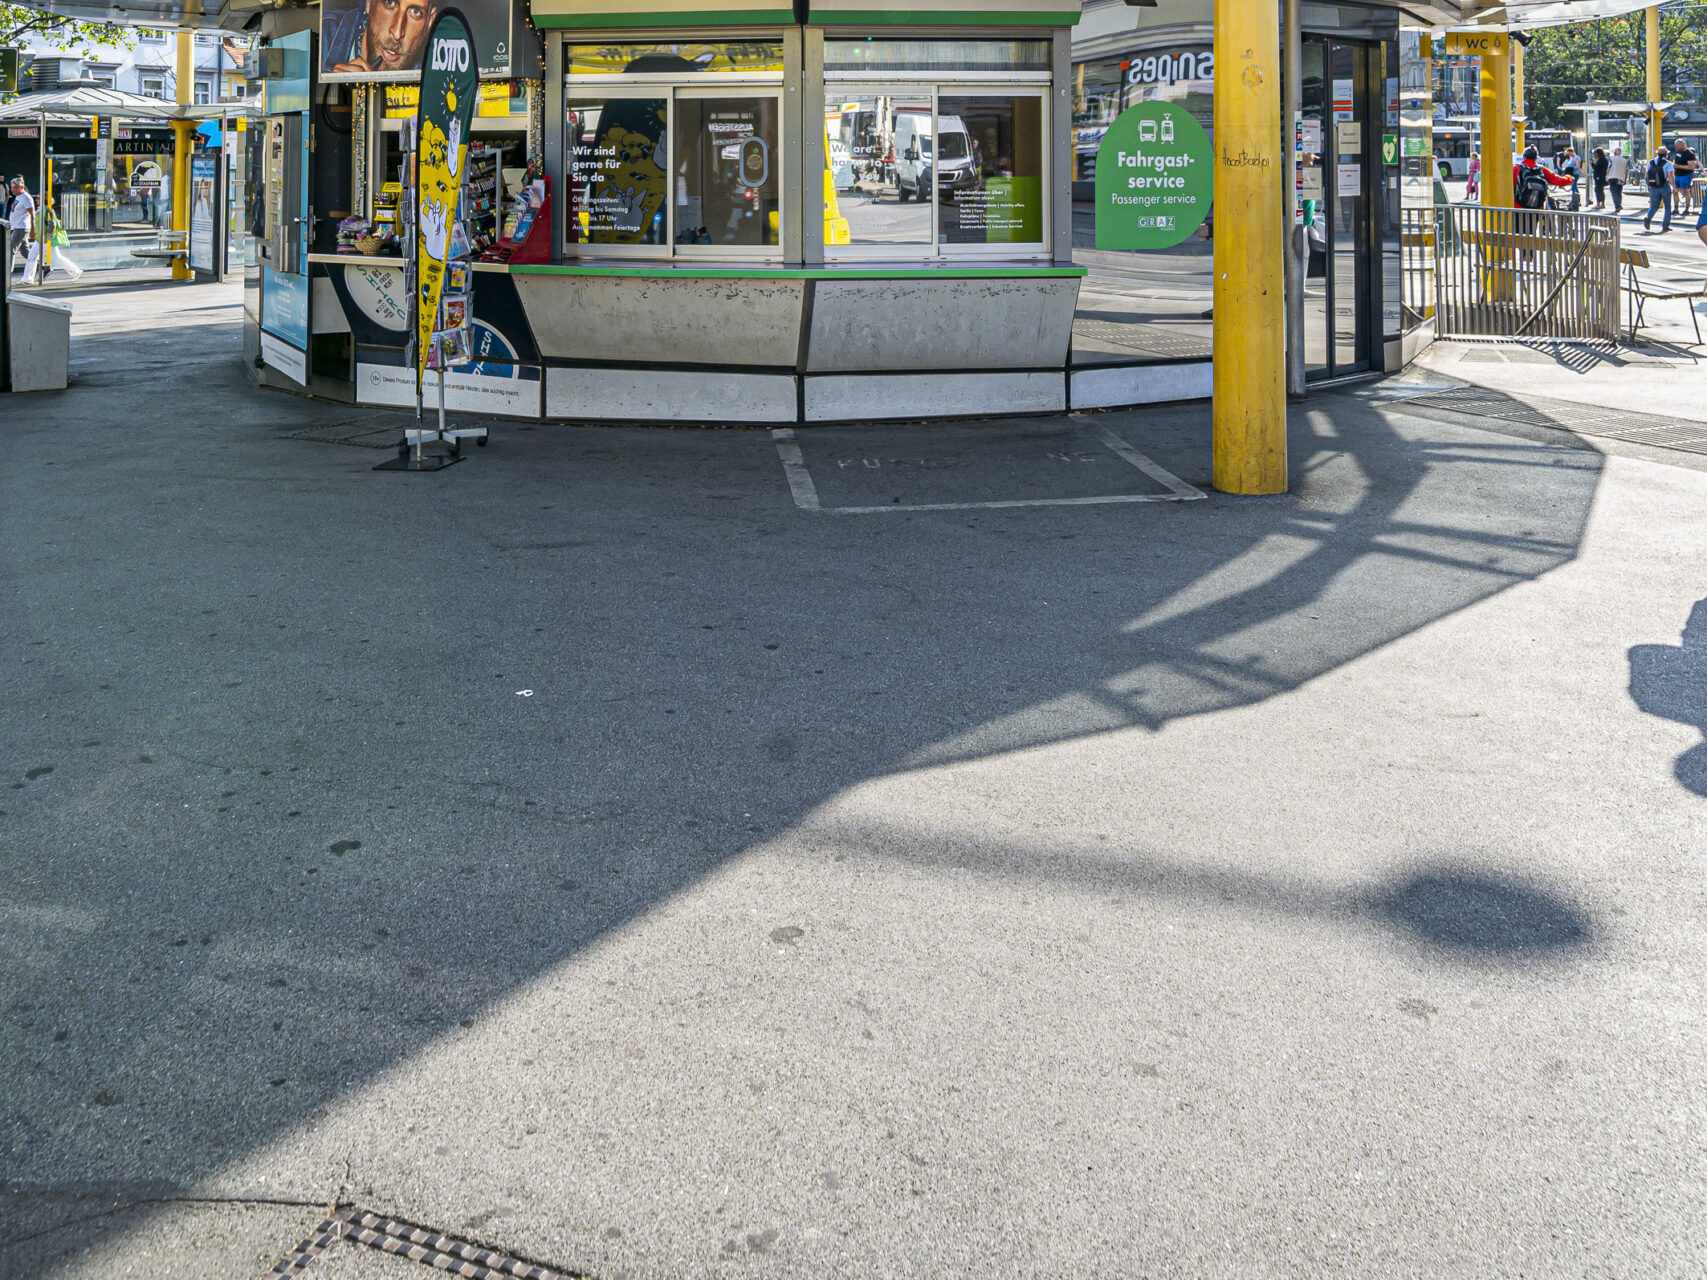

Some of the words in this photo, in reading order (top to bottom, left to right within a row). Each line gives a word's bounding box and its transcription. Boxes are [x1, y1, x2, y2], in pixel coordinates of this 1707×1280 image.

[1465, 38, 1488, 49] WC
[432, 38, 469, 73] LOTTO
[116, 142, 153, 152] ARTIN
[572, 146, 591, 156] Wir
[593, 146, 616, 156] sind
[572, 161, 603, 171] gerne
[605, 159, 621, 169] für
[1117, 150, 1195, 172] Fahrgast-
[571, 172, 588, 182] Sie
[590, 172, 605, 182] da
[859, 173, 880, 181] you
[1128, 172, 1185, 188] service
[1112, 193, 1160, 207] Passenger
[1163, 193, 1196, 204] service
[1138, 216, 1175, 228] GRAZ
